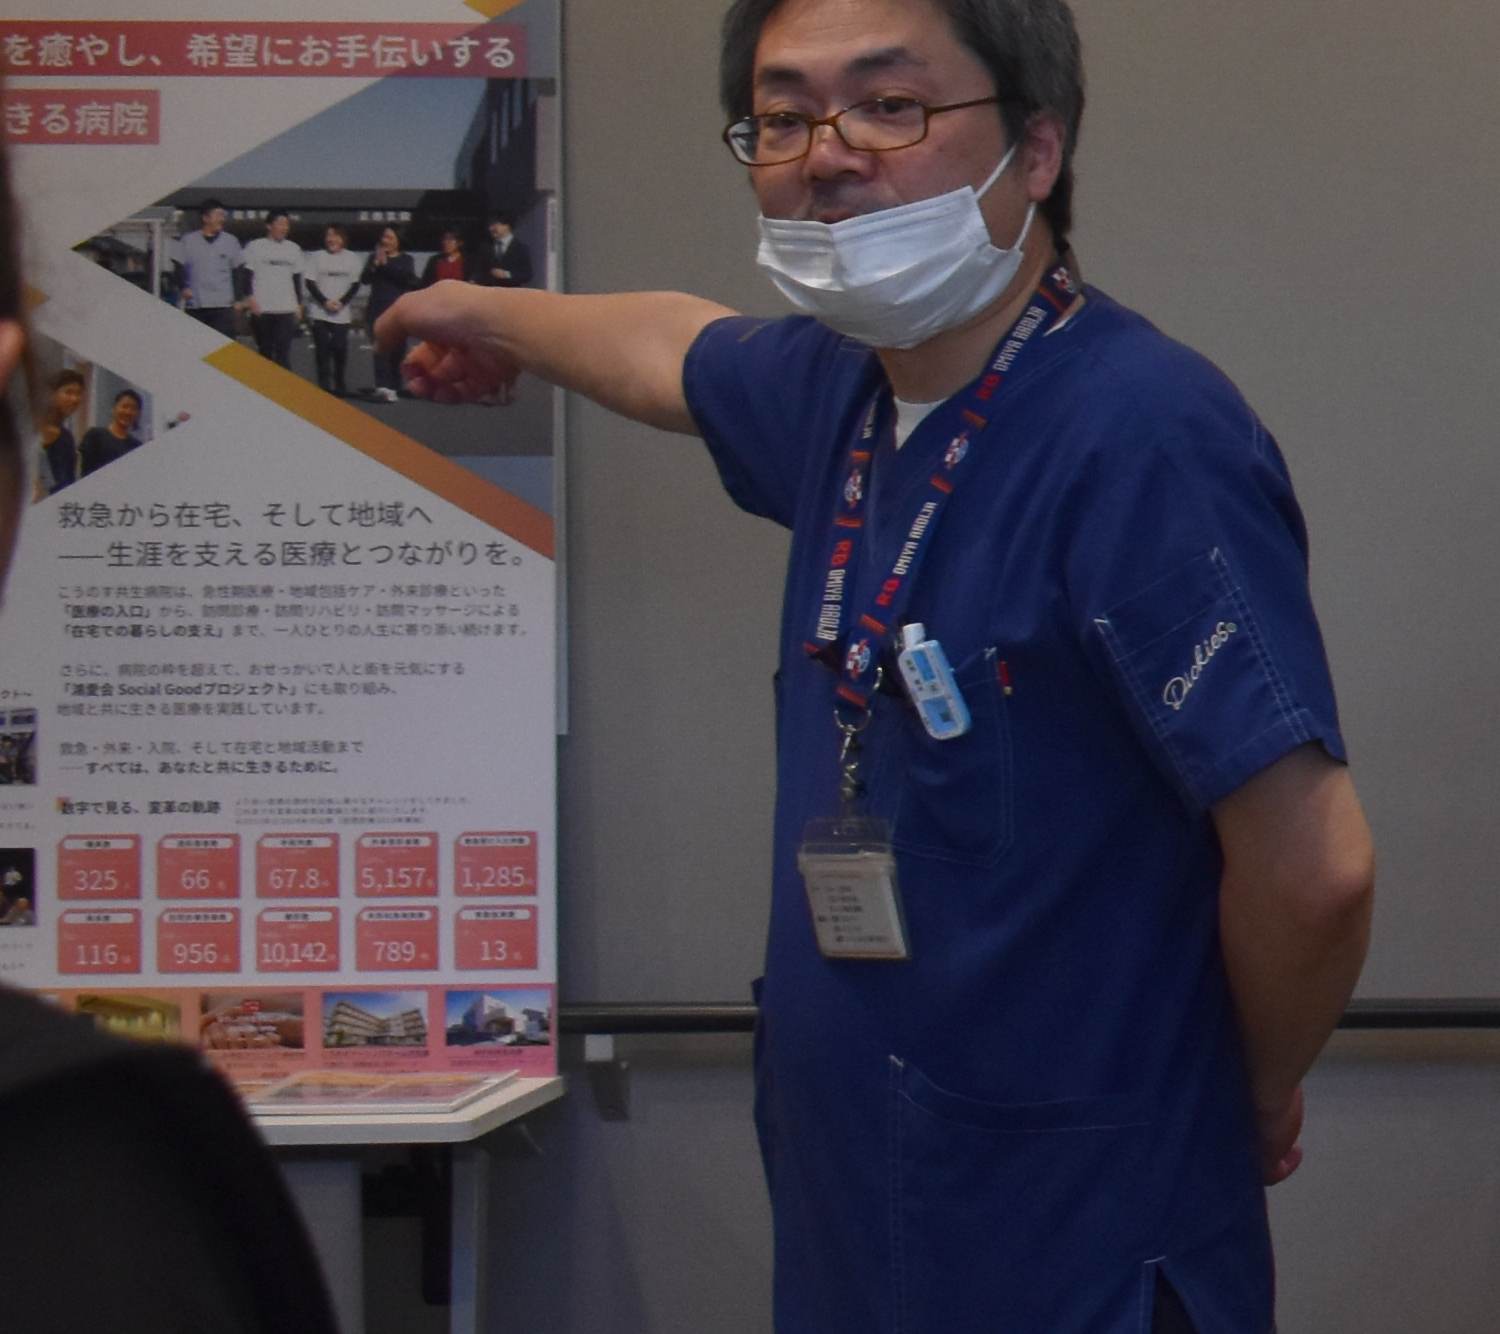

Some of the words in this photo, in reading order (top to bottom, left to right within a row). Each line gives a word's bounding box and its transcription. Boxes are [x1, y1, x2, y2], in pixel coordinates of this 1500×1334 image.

[58, 501, 433, 529] 救急から在宅、そして地域へ
[118, 683, 162, 696] Social
[74, 869, 119, 891] 325
[180, 868, 211, 890] 66
[269, 867, 320, 889] 67.8
[361, 866, 427, 892] 5,157
[461, 865, 526, 892] 1,285
[76, 944, 119, 966] 116
[173, 942, 218, 965] 956
[262, 942, 327, 968] 10,142
[372, 940, 417, 963] 789
[480, 939, 508, 962] 13
